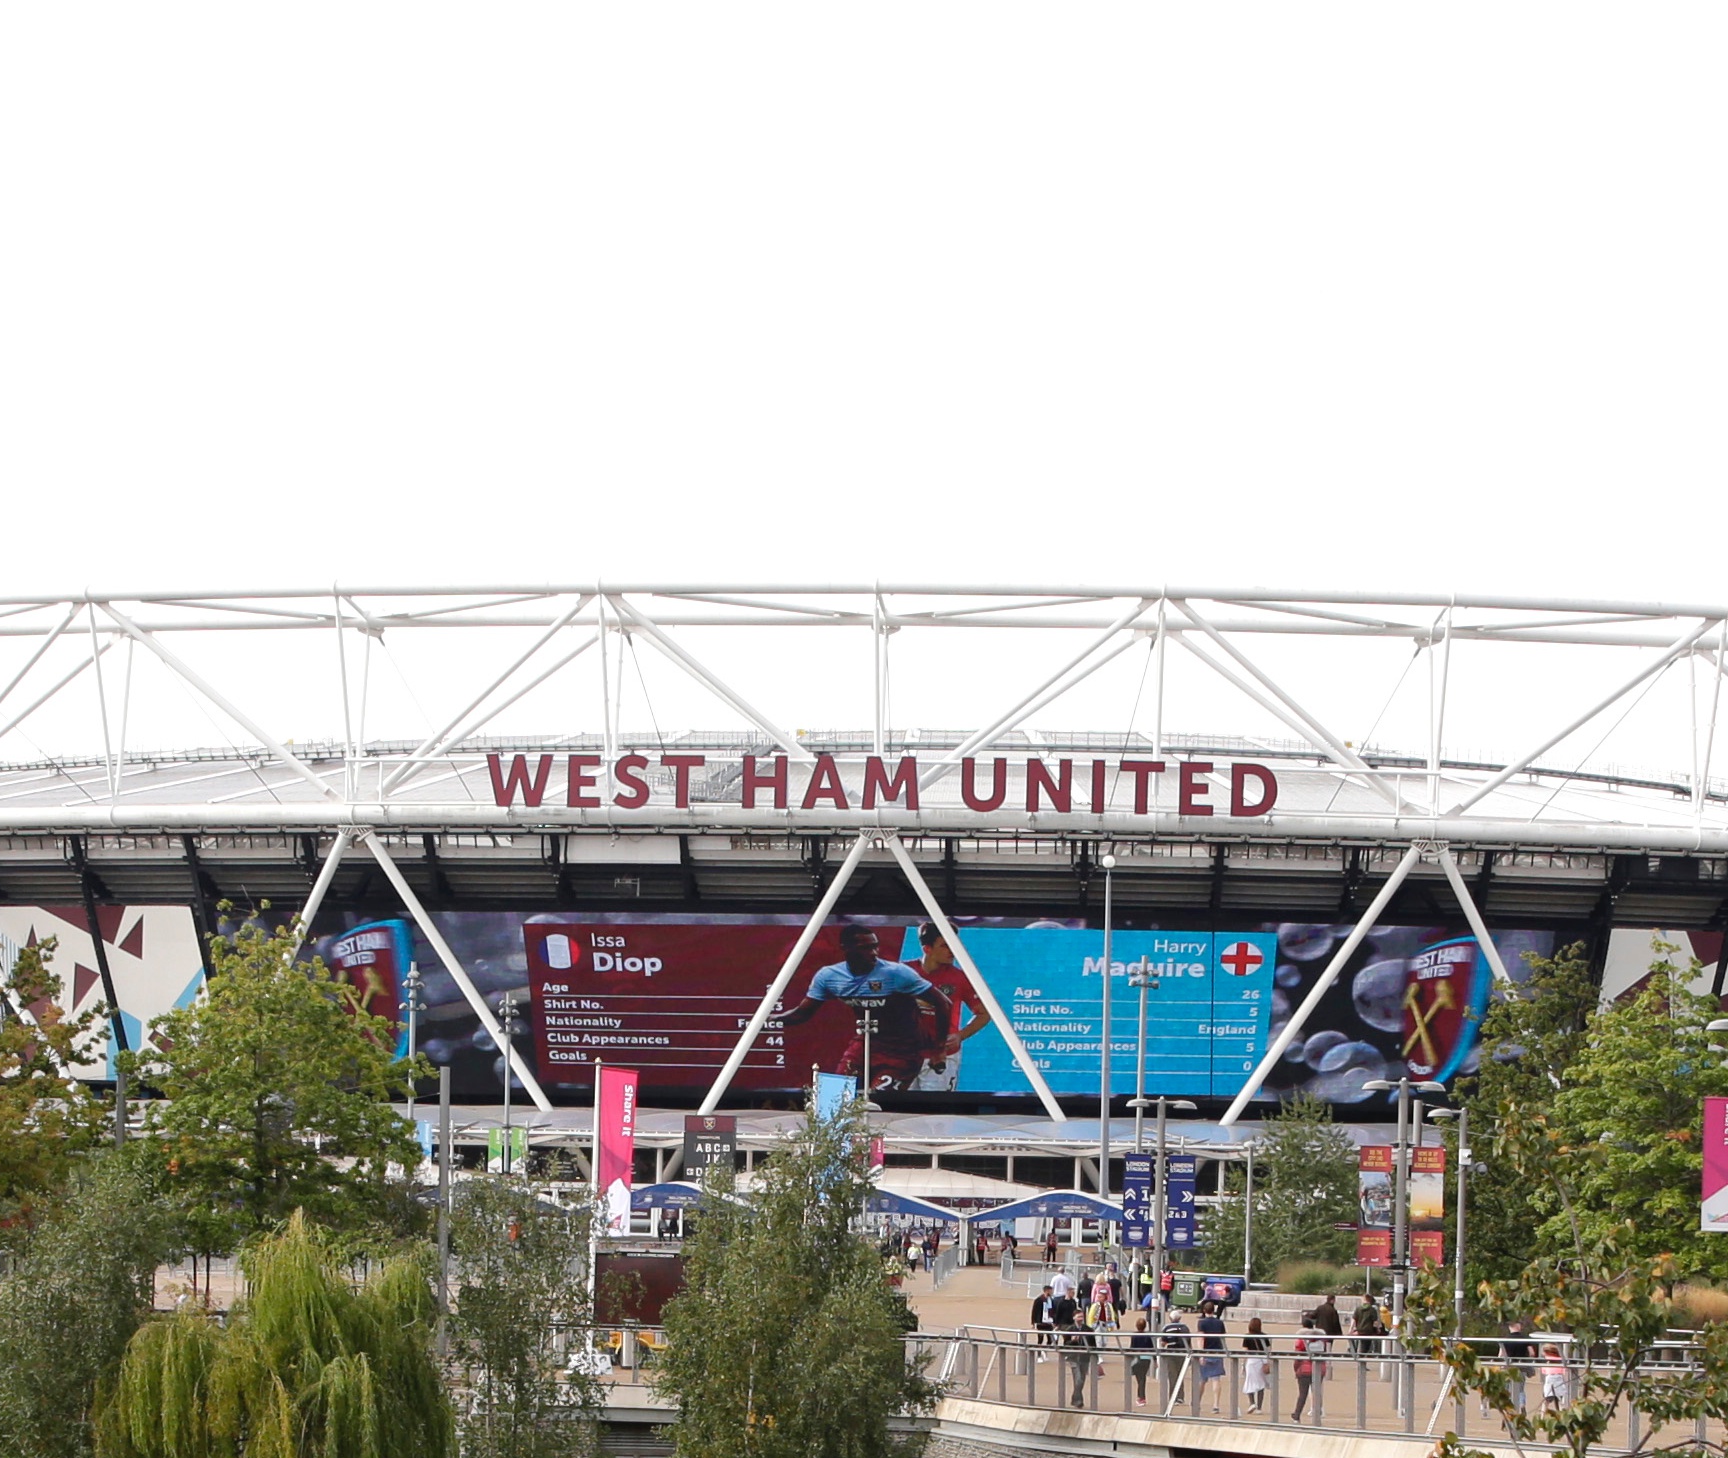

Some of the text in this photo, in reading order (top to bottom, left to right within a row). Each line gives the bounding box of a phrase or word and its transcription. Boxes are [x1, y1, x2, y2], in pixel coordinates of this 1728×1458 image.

[486, 753, 1278, 818] WEST HAM UNITED
[591, 932, 626, 947] Issa
[1154, 939, 1207, 956] Harry
[593, 952, 662, 976] Diop
[542, 982, 569, 993] Age
[1014, 987, 1260, 999] Age 26
[544, 999, 577, 1009] Shirt
[581, 1000, 604, 1009] No.
[1013, 1004, 1258, 1017] Shirt No. 5
[545, 1016, 784, 1028] Nationality Frnce
[1014, 1022, 1256, 1036] Nationality England
[547, 1033, 784, 1046] Club Appearances 44
[1023, 1040, 1045, 1050] lub
[1246, 1043, 1255, 1052] 5
[549, 1050, 784, 1064] Goals 2
[1243, 1061, 1252, 1071] 0
[623, 1084, 633, 1123] Share
[696, 1143, 721, 1152] A B C
[1141, 1190, 1149, 1201] 1
